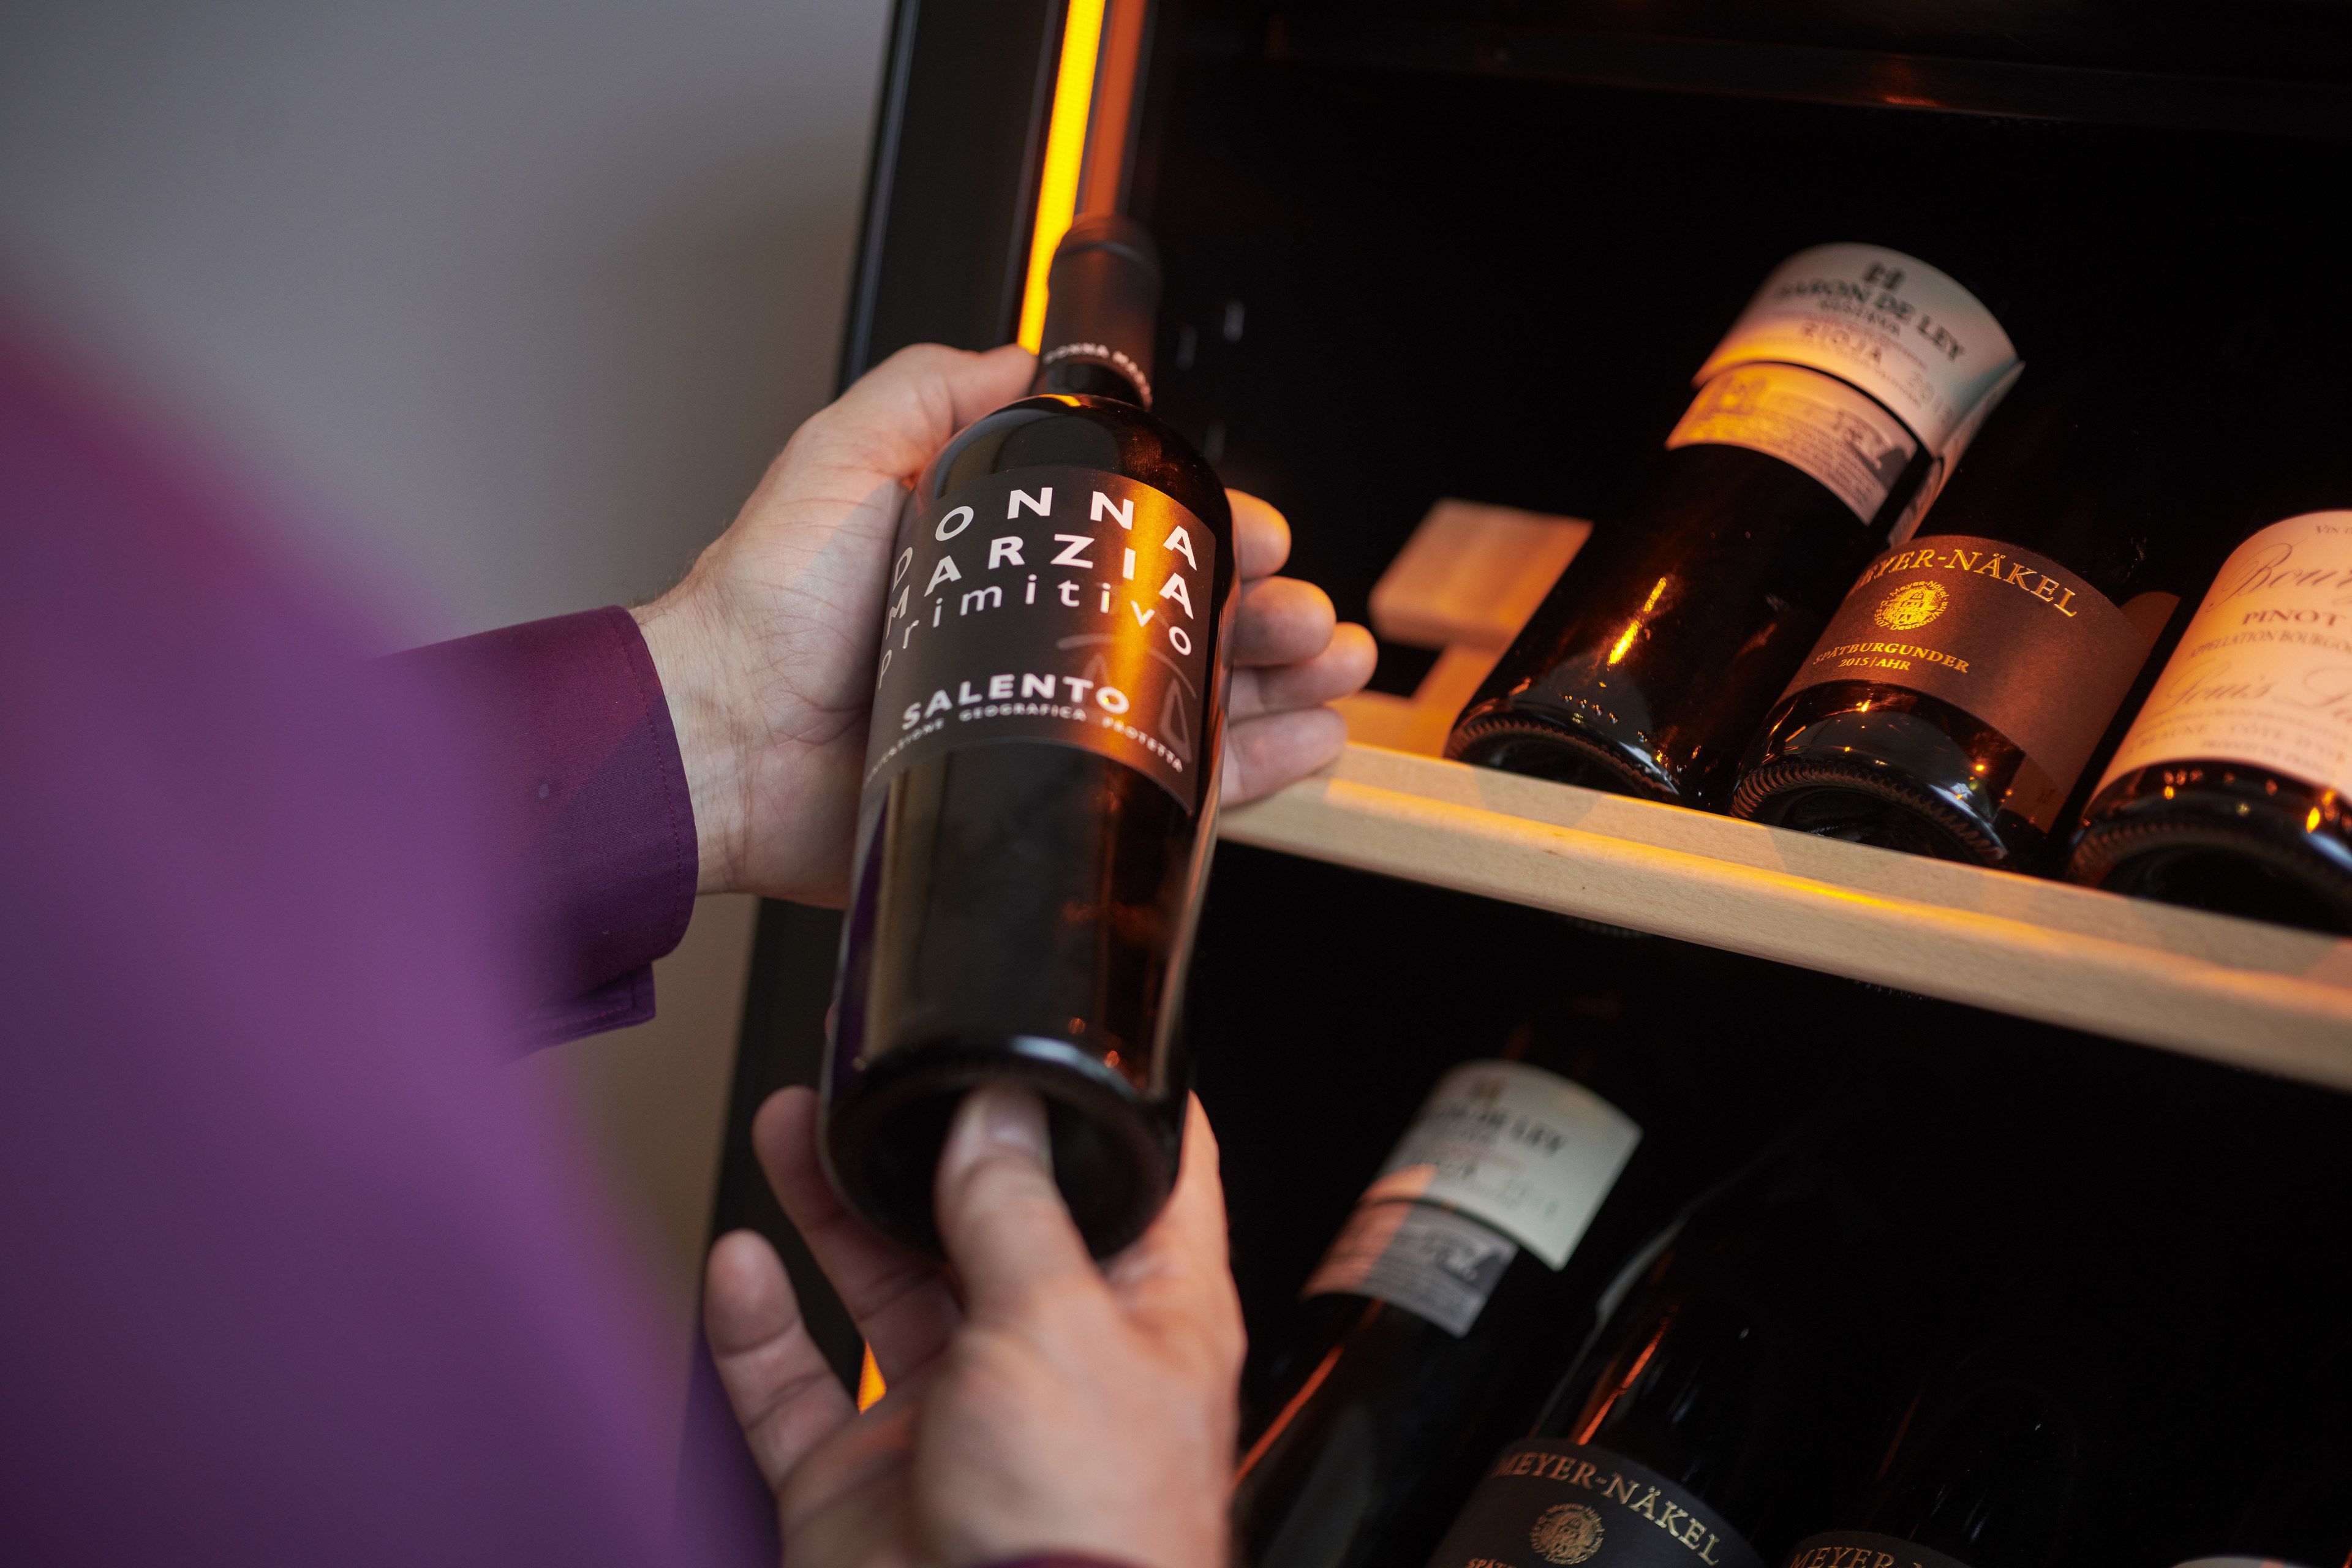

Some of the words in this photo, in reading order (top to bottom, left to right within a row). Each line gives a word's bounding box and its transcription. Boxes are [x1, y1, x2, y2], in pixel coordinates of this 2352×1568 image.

[1917, 314, 1965, 362] LEY
[892, 487, 1197, 593] DONNA
[886, 533, 1194, 640] MARZIA
[2242, 609, 2347, 627] PINOT
[878, 574, 1192, 690] primitivo
[1813, 643, 1970, 673] SPÄTBURGUNDER
[902, 673, 1129, 730] SALENTO
[959, 703, 1087, 722] GEOGRAFICA
[1102, 715, 1183, 772] PROTETTA
[1491, 1452, 1720, 1566] MEYER-NÄKEL
